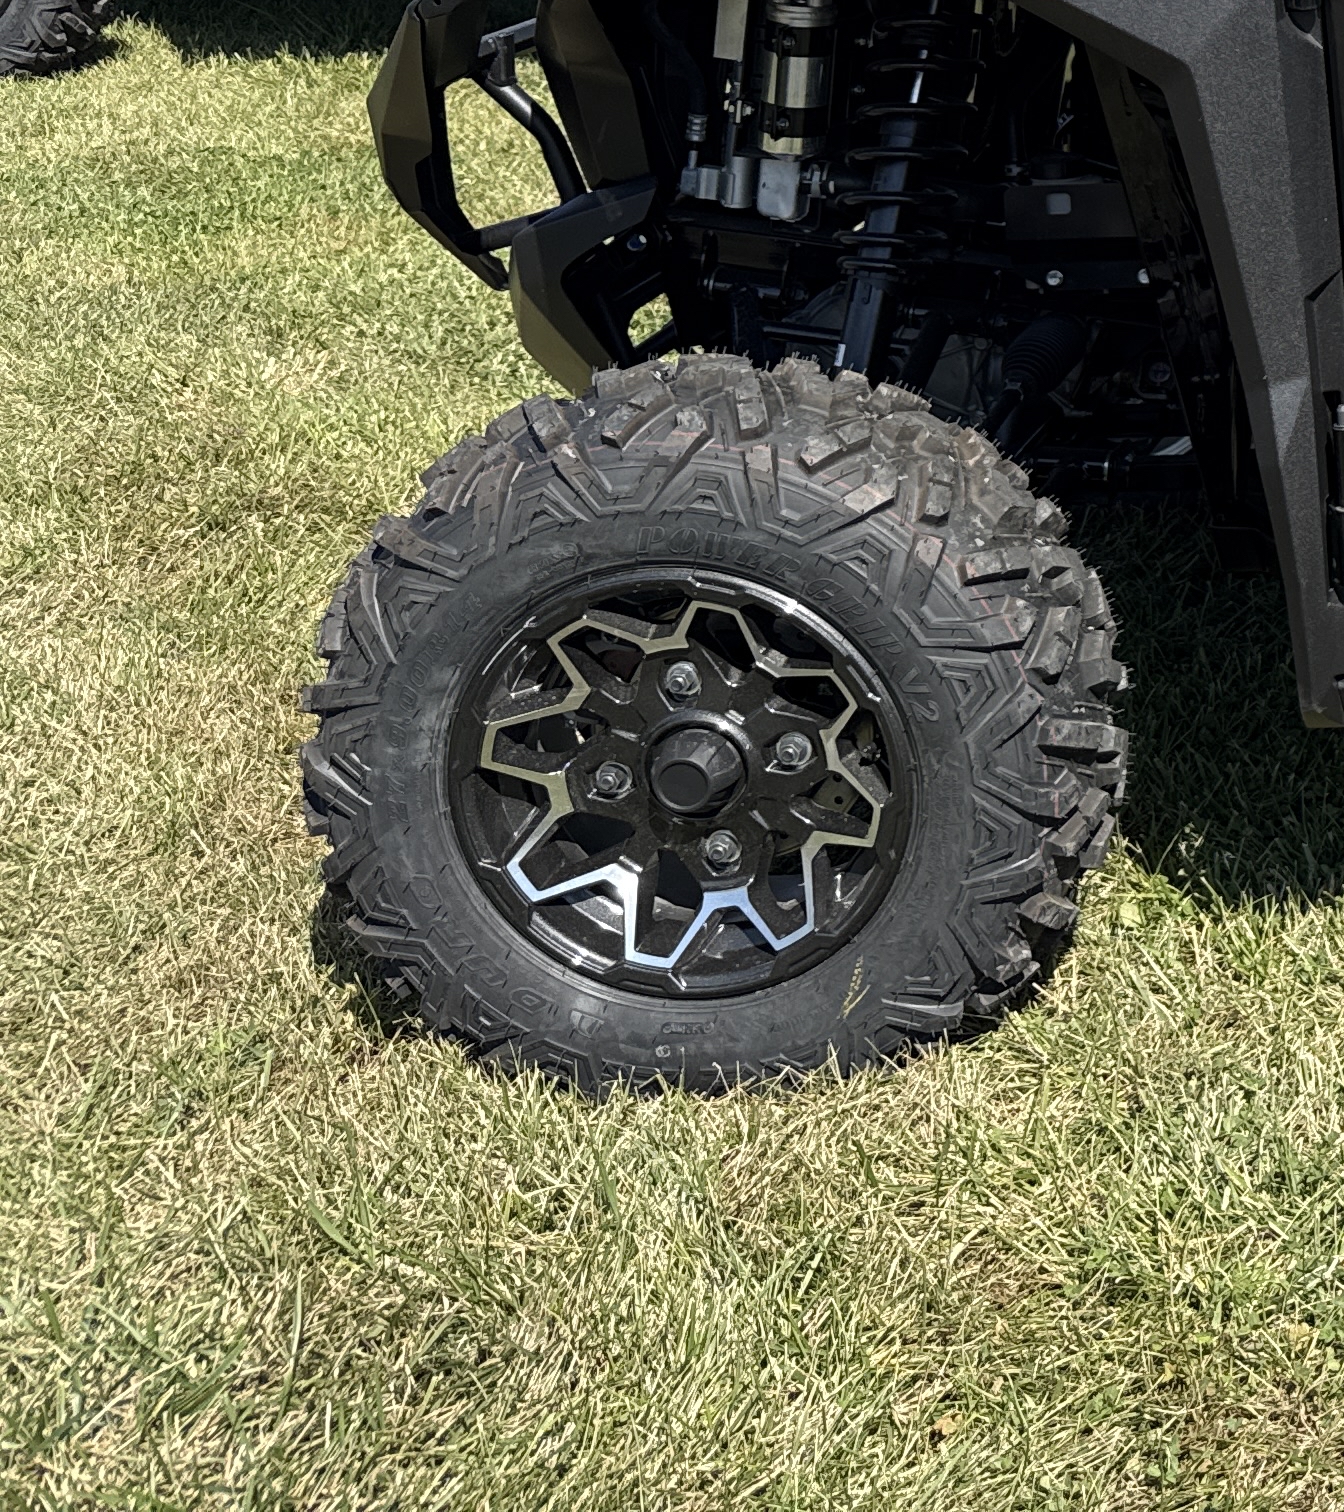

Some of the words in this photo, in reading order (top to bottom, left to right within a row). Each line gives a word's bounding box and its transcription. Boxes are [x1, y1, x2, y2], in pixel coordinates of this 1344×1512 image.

[636, 525, 801, 583] POWER
[805, 577, 905, 655] GRIP
[898, 664, 941, 724] V2
[408, 872, 556, 1016] DURO
